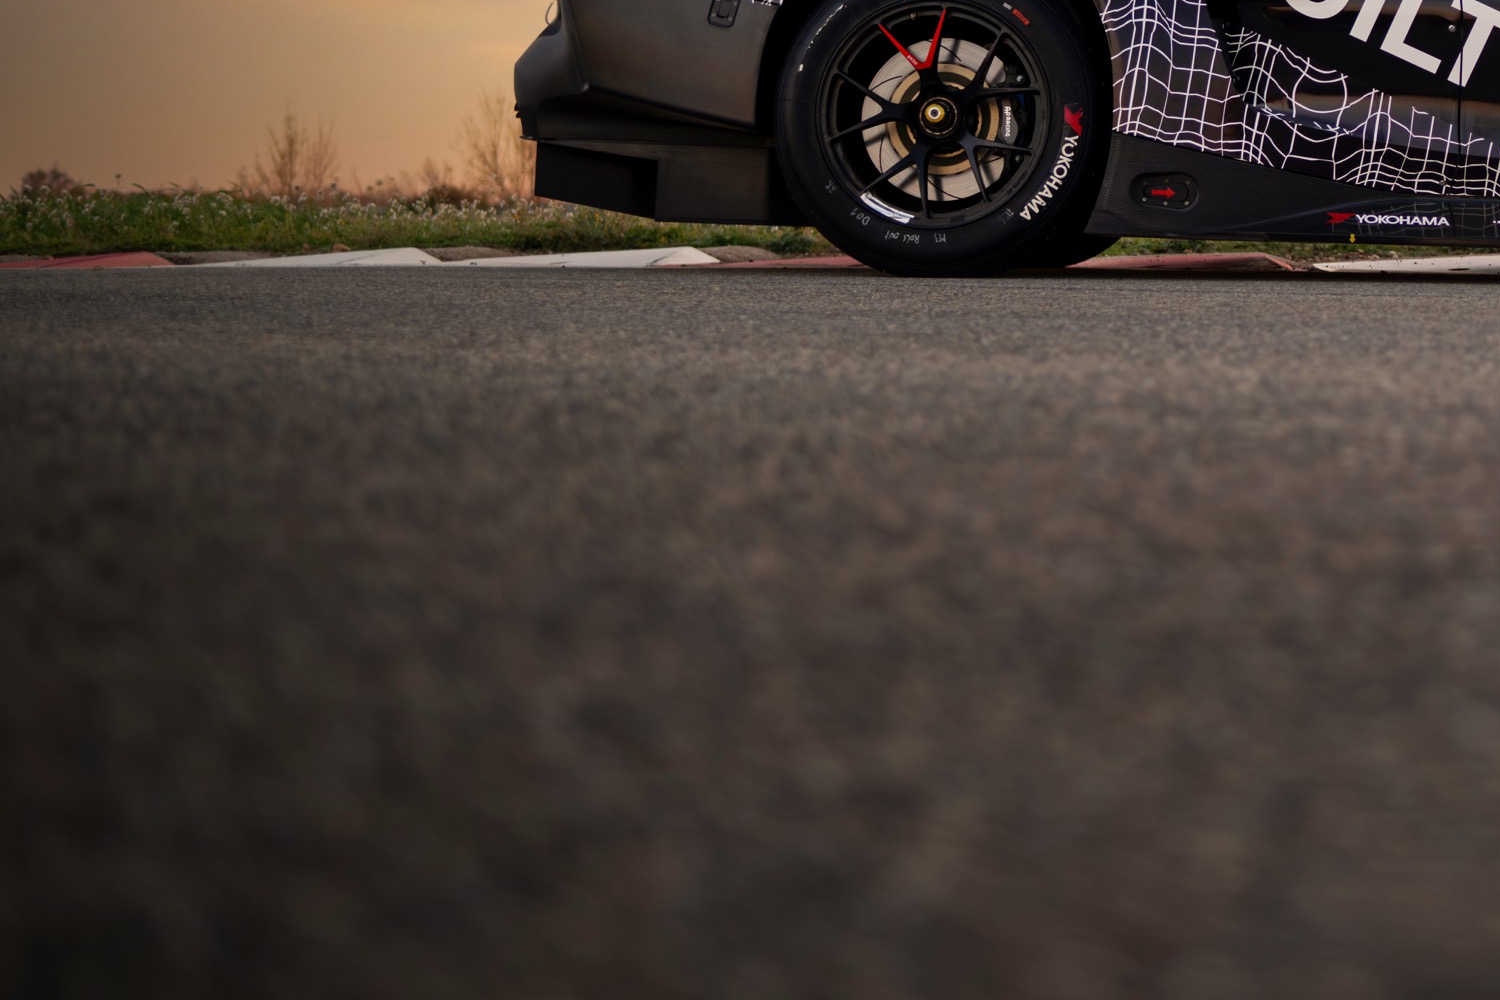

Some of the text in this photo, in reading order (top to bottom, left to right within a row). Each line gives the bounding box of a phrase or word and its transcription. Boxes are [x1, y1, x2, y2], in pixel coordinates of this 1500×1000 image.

[1004, 106, 1011, 117] AP
[1019, 135, 1079, 221] YOKOHAMA
[850, 207, 871, 226] D01
[1356, 214, 1450, 227] YOKOHAMA
[933, 233, 947, 243] M3
